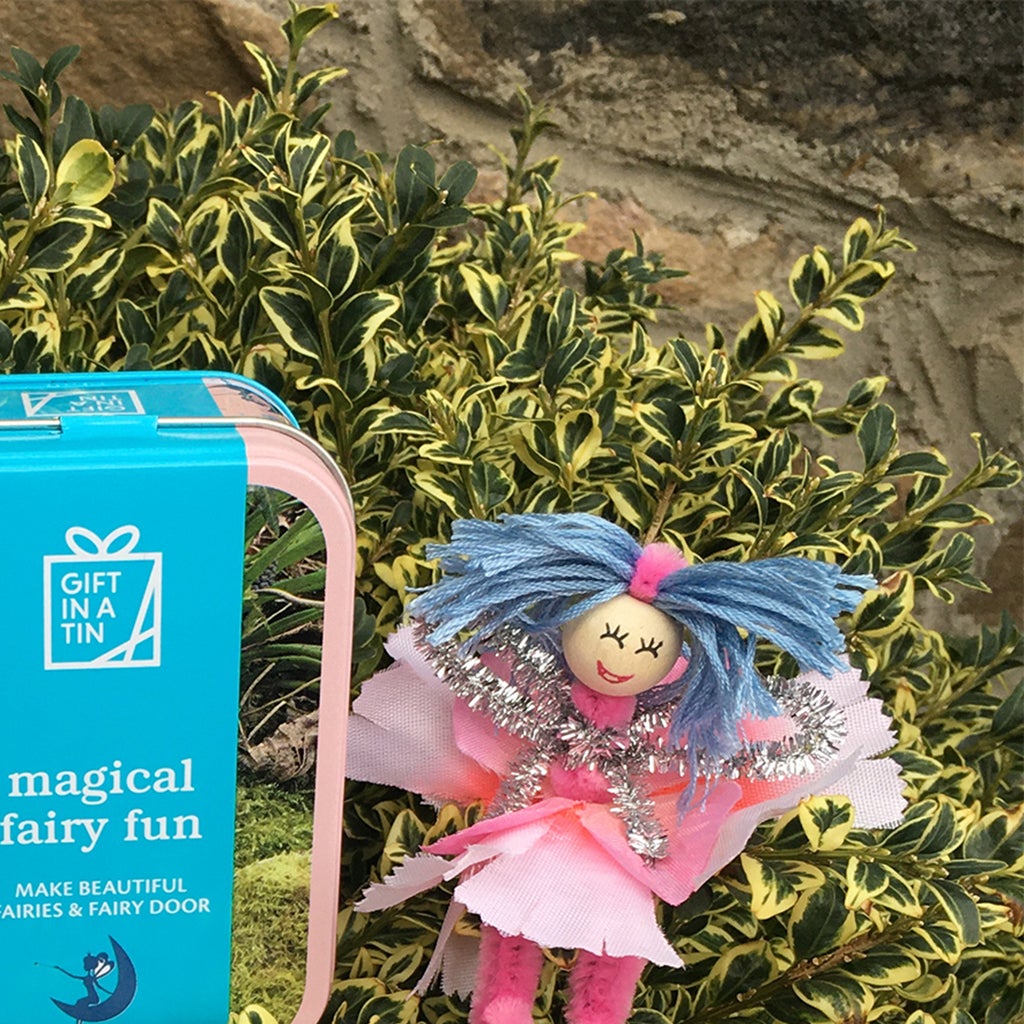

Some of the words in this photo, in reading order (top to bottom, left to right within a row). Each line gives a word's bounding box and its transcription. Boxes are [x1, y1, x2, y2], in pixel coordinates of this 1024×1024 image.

[61, 572, 122, 595] GIFT
[62, 598, 89, 619] IN
[96, 597, 116, 618] A
[61, 622, 104, 644] TIN
[8, 758, 195, 805] magical
[0, 811, 109, 853] fairy
[123, 808, 203, 842] fun
[15, 881, 73, 898] MAKE
[79, 878, 187, 896] BEAUTIFUL
[68, 902, 83, 918] &
[89, 900, 144, 917] FAIRY
[149, 898, 210, 915] DOOR
